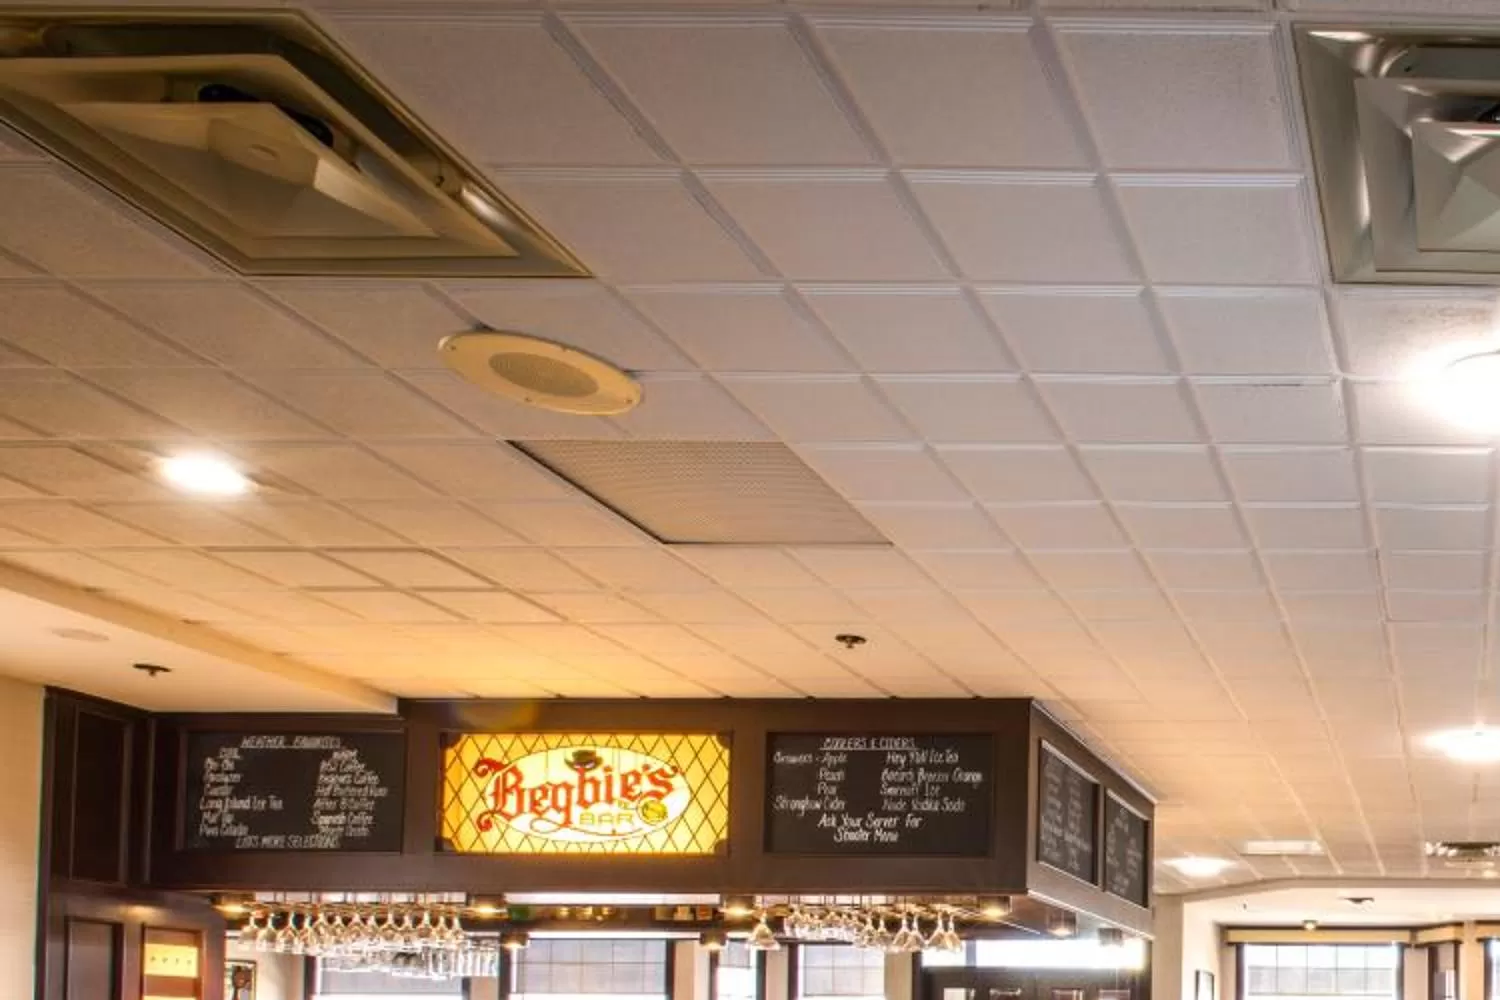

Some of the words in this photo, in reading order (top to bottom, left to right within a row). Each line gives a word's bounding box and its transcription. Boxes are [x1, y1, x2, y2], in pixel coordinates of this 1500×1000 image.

[474, 757, 684, 832] Begbie's
[579, 812, 635, 826] BAR
[816, 812, 838, 828] Ask
[842, 812, 864, 828] Your
[865, 811, 900, 829] Server
[872, 827, 900, 844] Menu
